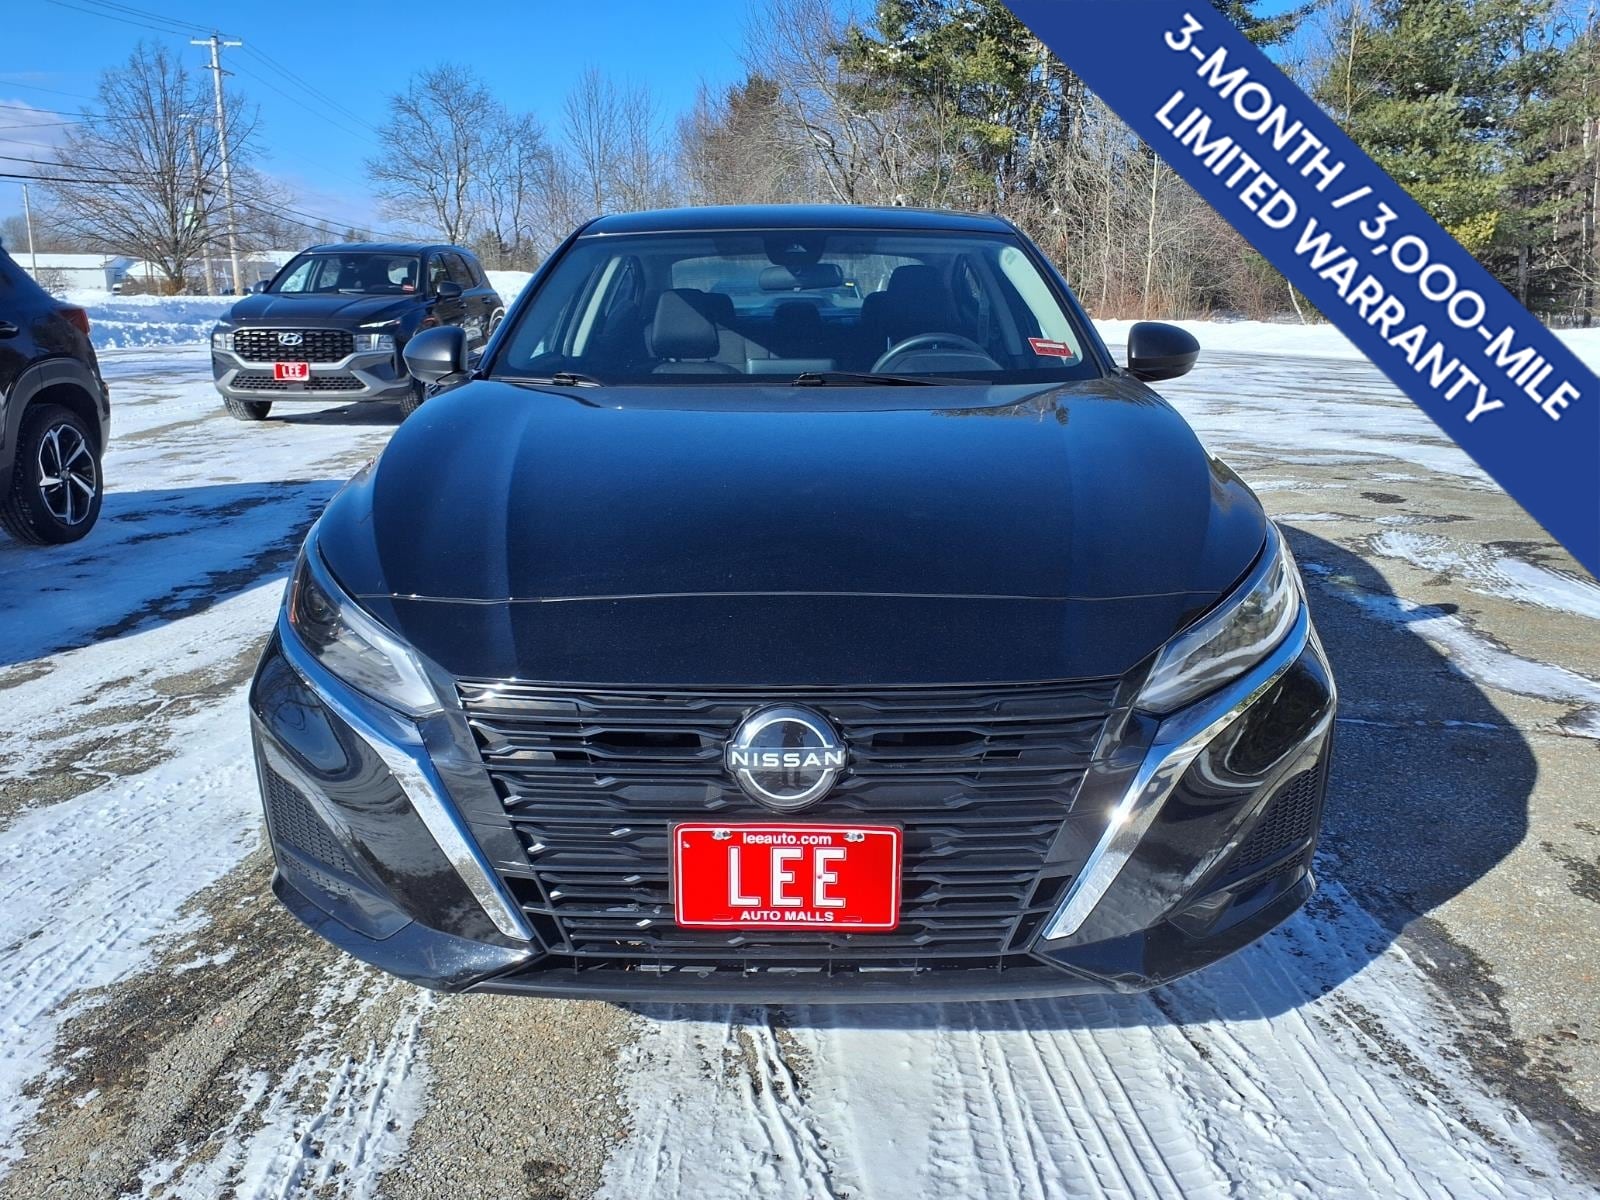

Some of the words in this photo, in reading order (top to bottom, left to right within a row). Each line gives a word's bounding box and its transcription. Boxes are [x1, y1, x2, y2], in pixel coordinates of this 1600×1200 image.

[282, 365, 304, 377] LEE
[731, 751, 842, 768] NISSAN
[742, 833, 832, 845] leeauto.com
[728, 846, 847, 908] LEE
[740, 910, 781, 922] AUTO
[784, 910, 834, 923] MALLS
